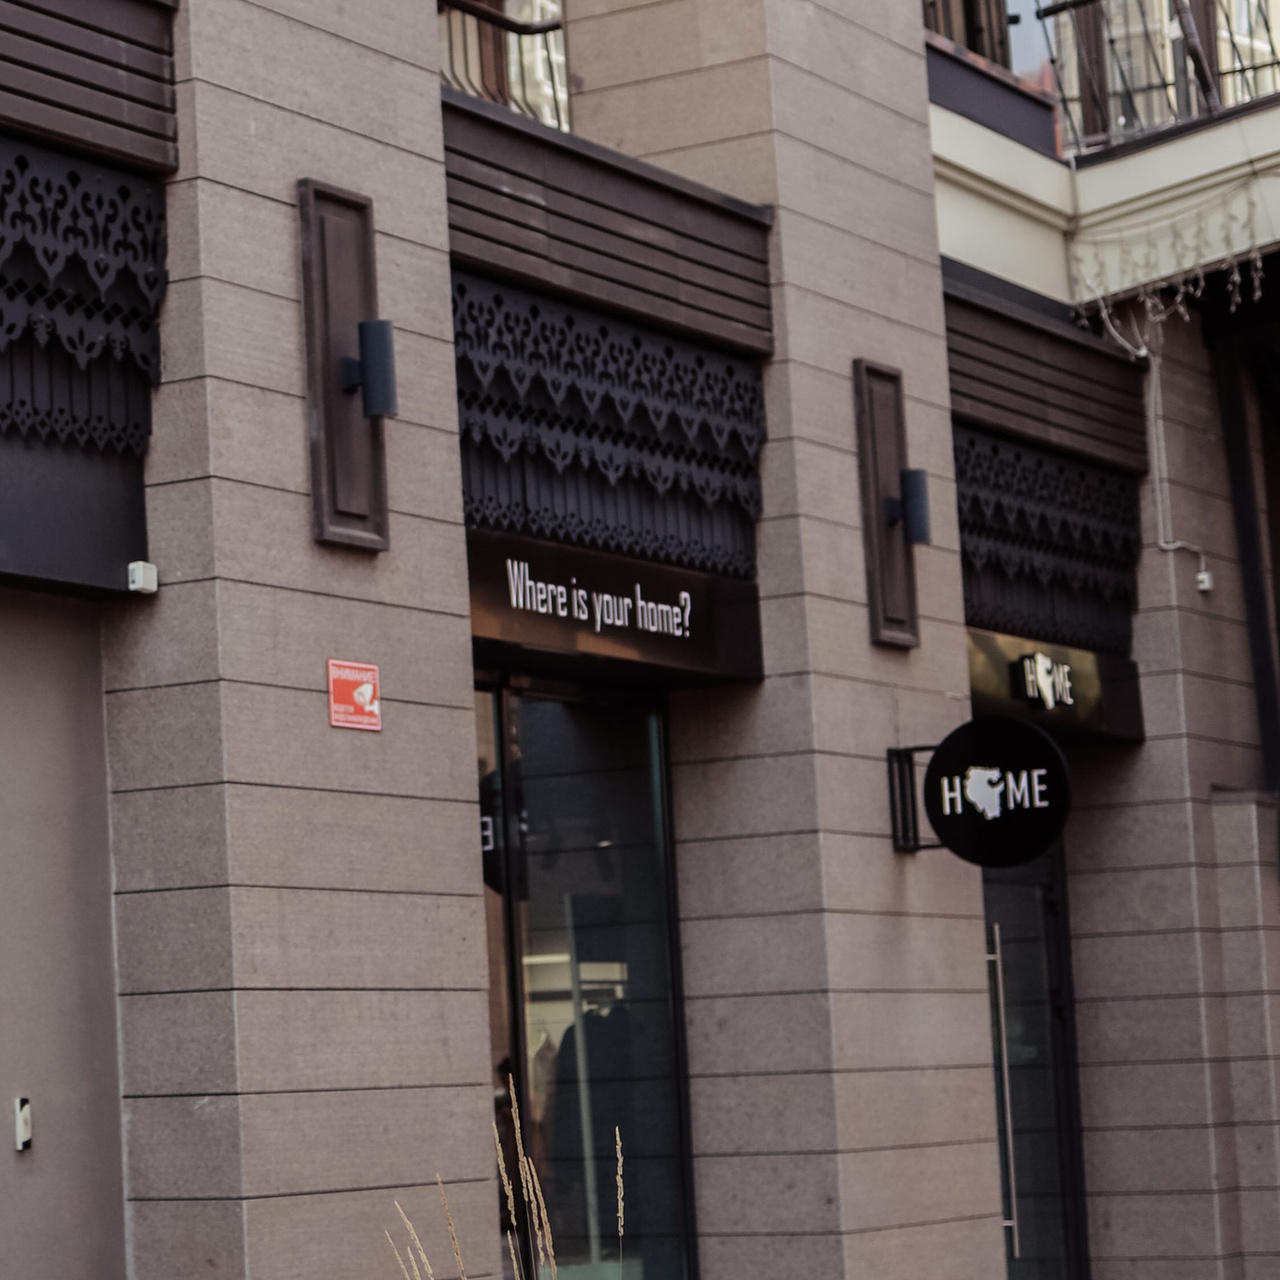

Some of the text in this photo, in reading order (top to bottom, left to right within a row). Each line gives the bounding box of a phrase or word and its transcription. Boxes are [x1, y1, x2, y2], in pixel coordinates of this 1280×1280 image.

[506, 558, 692, 639] Where is your home?
